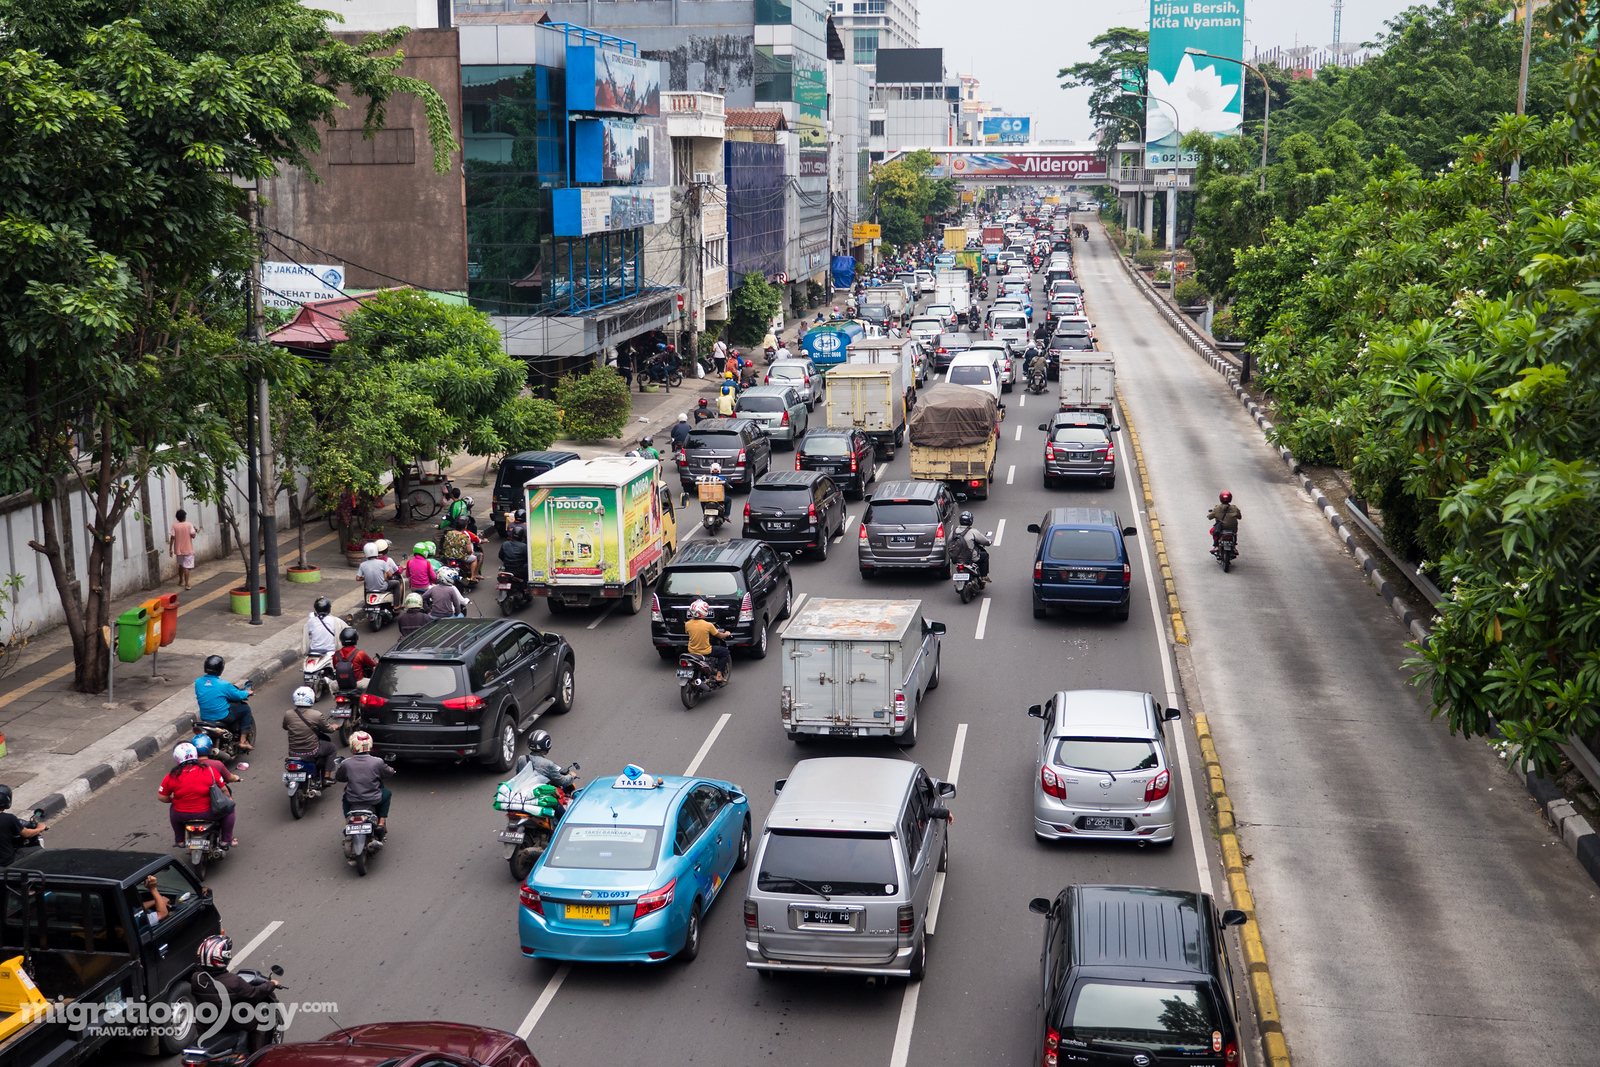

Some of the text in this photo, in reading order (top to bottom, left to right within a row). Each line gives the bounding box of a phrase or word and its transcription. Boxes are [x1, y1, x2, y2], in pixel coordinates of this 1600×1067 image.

[1153, 1, 1240, 17] Hijau Bersih,
[1152, 16, 1241, 30] Kita Nyaman
[1019, 157, 1089, 172] Alderon
[267, 265, 315, 276] 2 JAKARTA
[280, 289, 312, 299] SEHAT
[314, 291, 334, 300] DAN
[631, 476, 649, 498] DOUGO
[556, 501, 594, 509] DOUGO
[610, 890, 630, 898] 6937
[814, 911, 833, 920] 8027
[839, 912, 850, 920] FB
